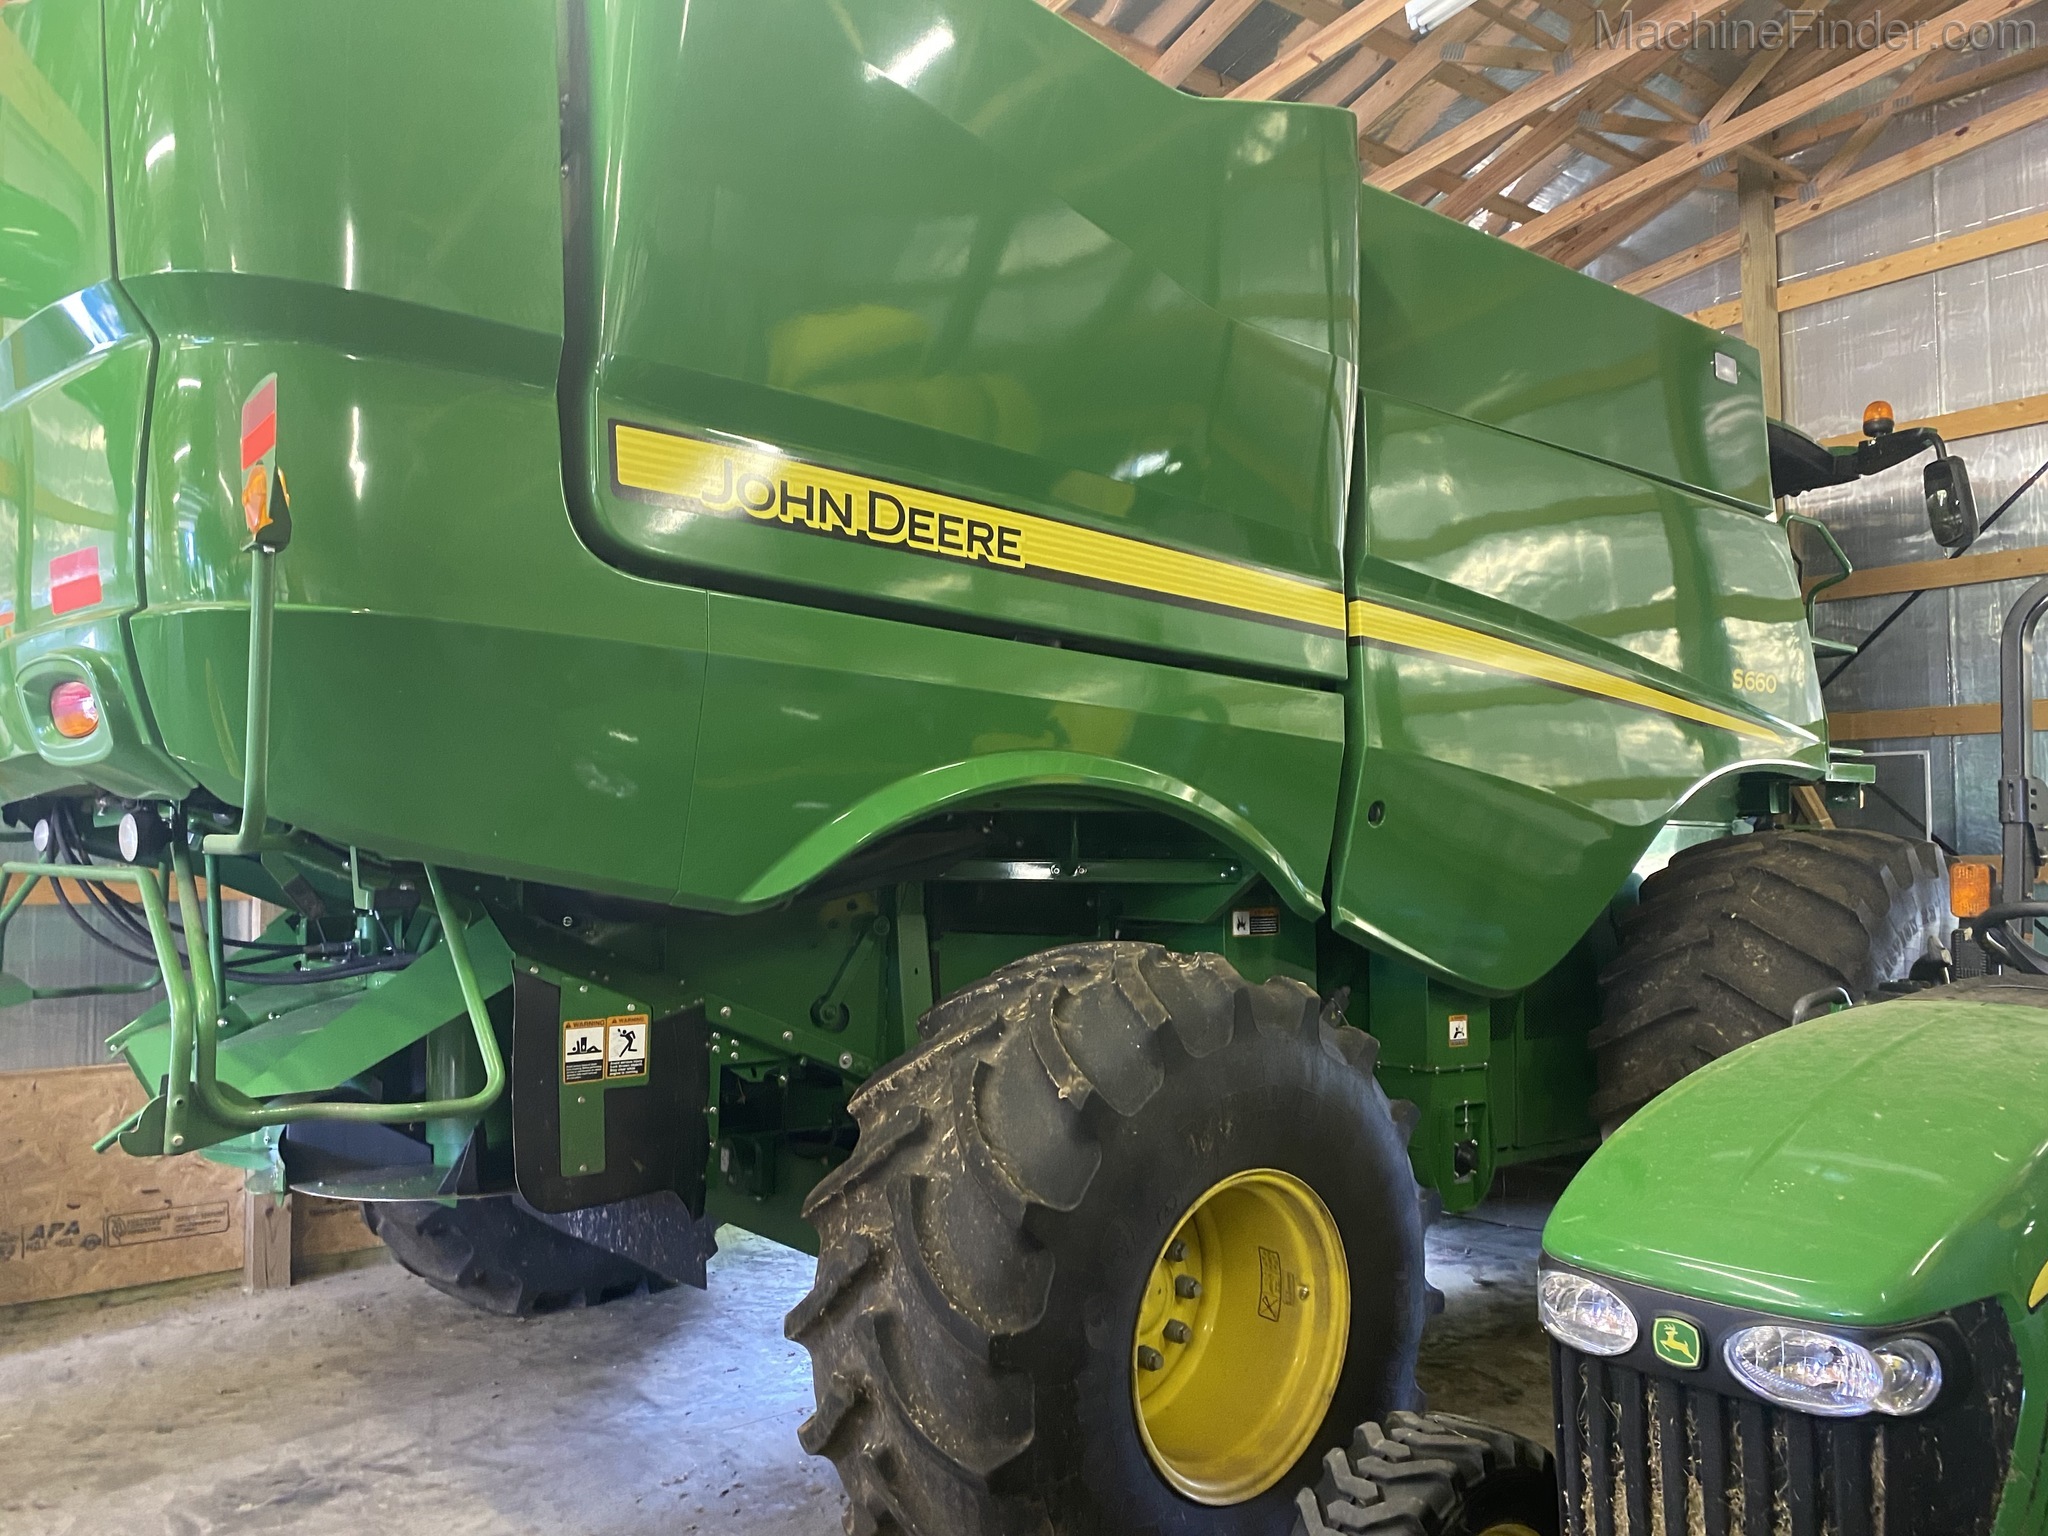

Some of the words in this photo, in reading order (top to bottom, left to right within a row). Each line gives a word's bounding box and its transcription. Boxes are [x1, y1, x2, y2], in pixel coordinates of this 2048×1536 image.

[701, 457, 855, 533] JOHN
[867, 490, 1024, 565] DEERE
[1732, 668, 1777, 694] S660
[573, 1019, 605, 1027] WARNING
